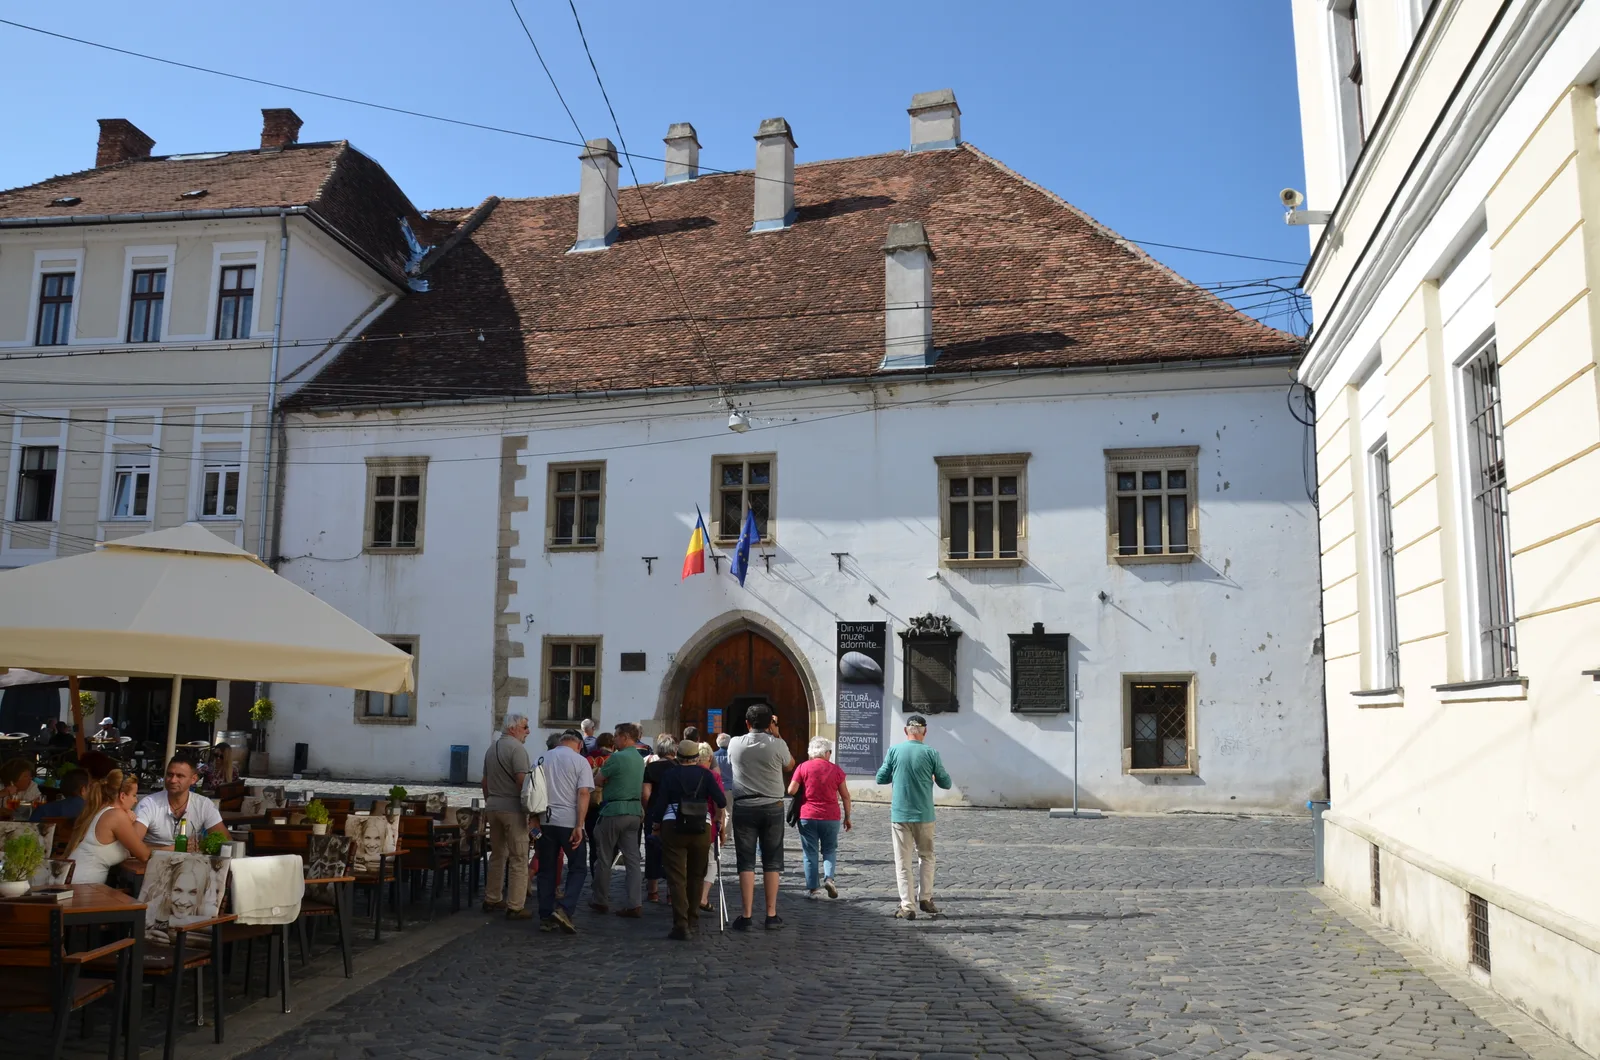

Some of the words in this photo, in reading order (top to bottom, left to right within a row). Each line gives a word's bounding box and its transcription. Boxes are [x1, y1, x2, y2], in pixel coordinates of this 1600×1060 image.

[840, 623, 854, 632] Din
[856, 623, 874, 632] visul
[839, 700, 880, 709] SCULPTURĂ
